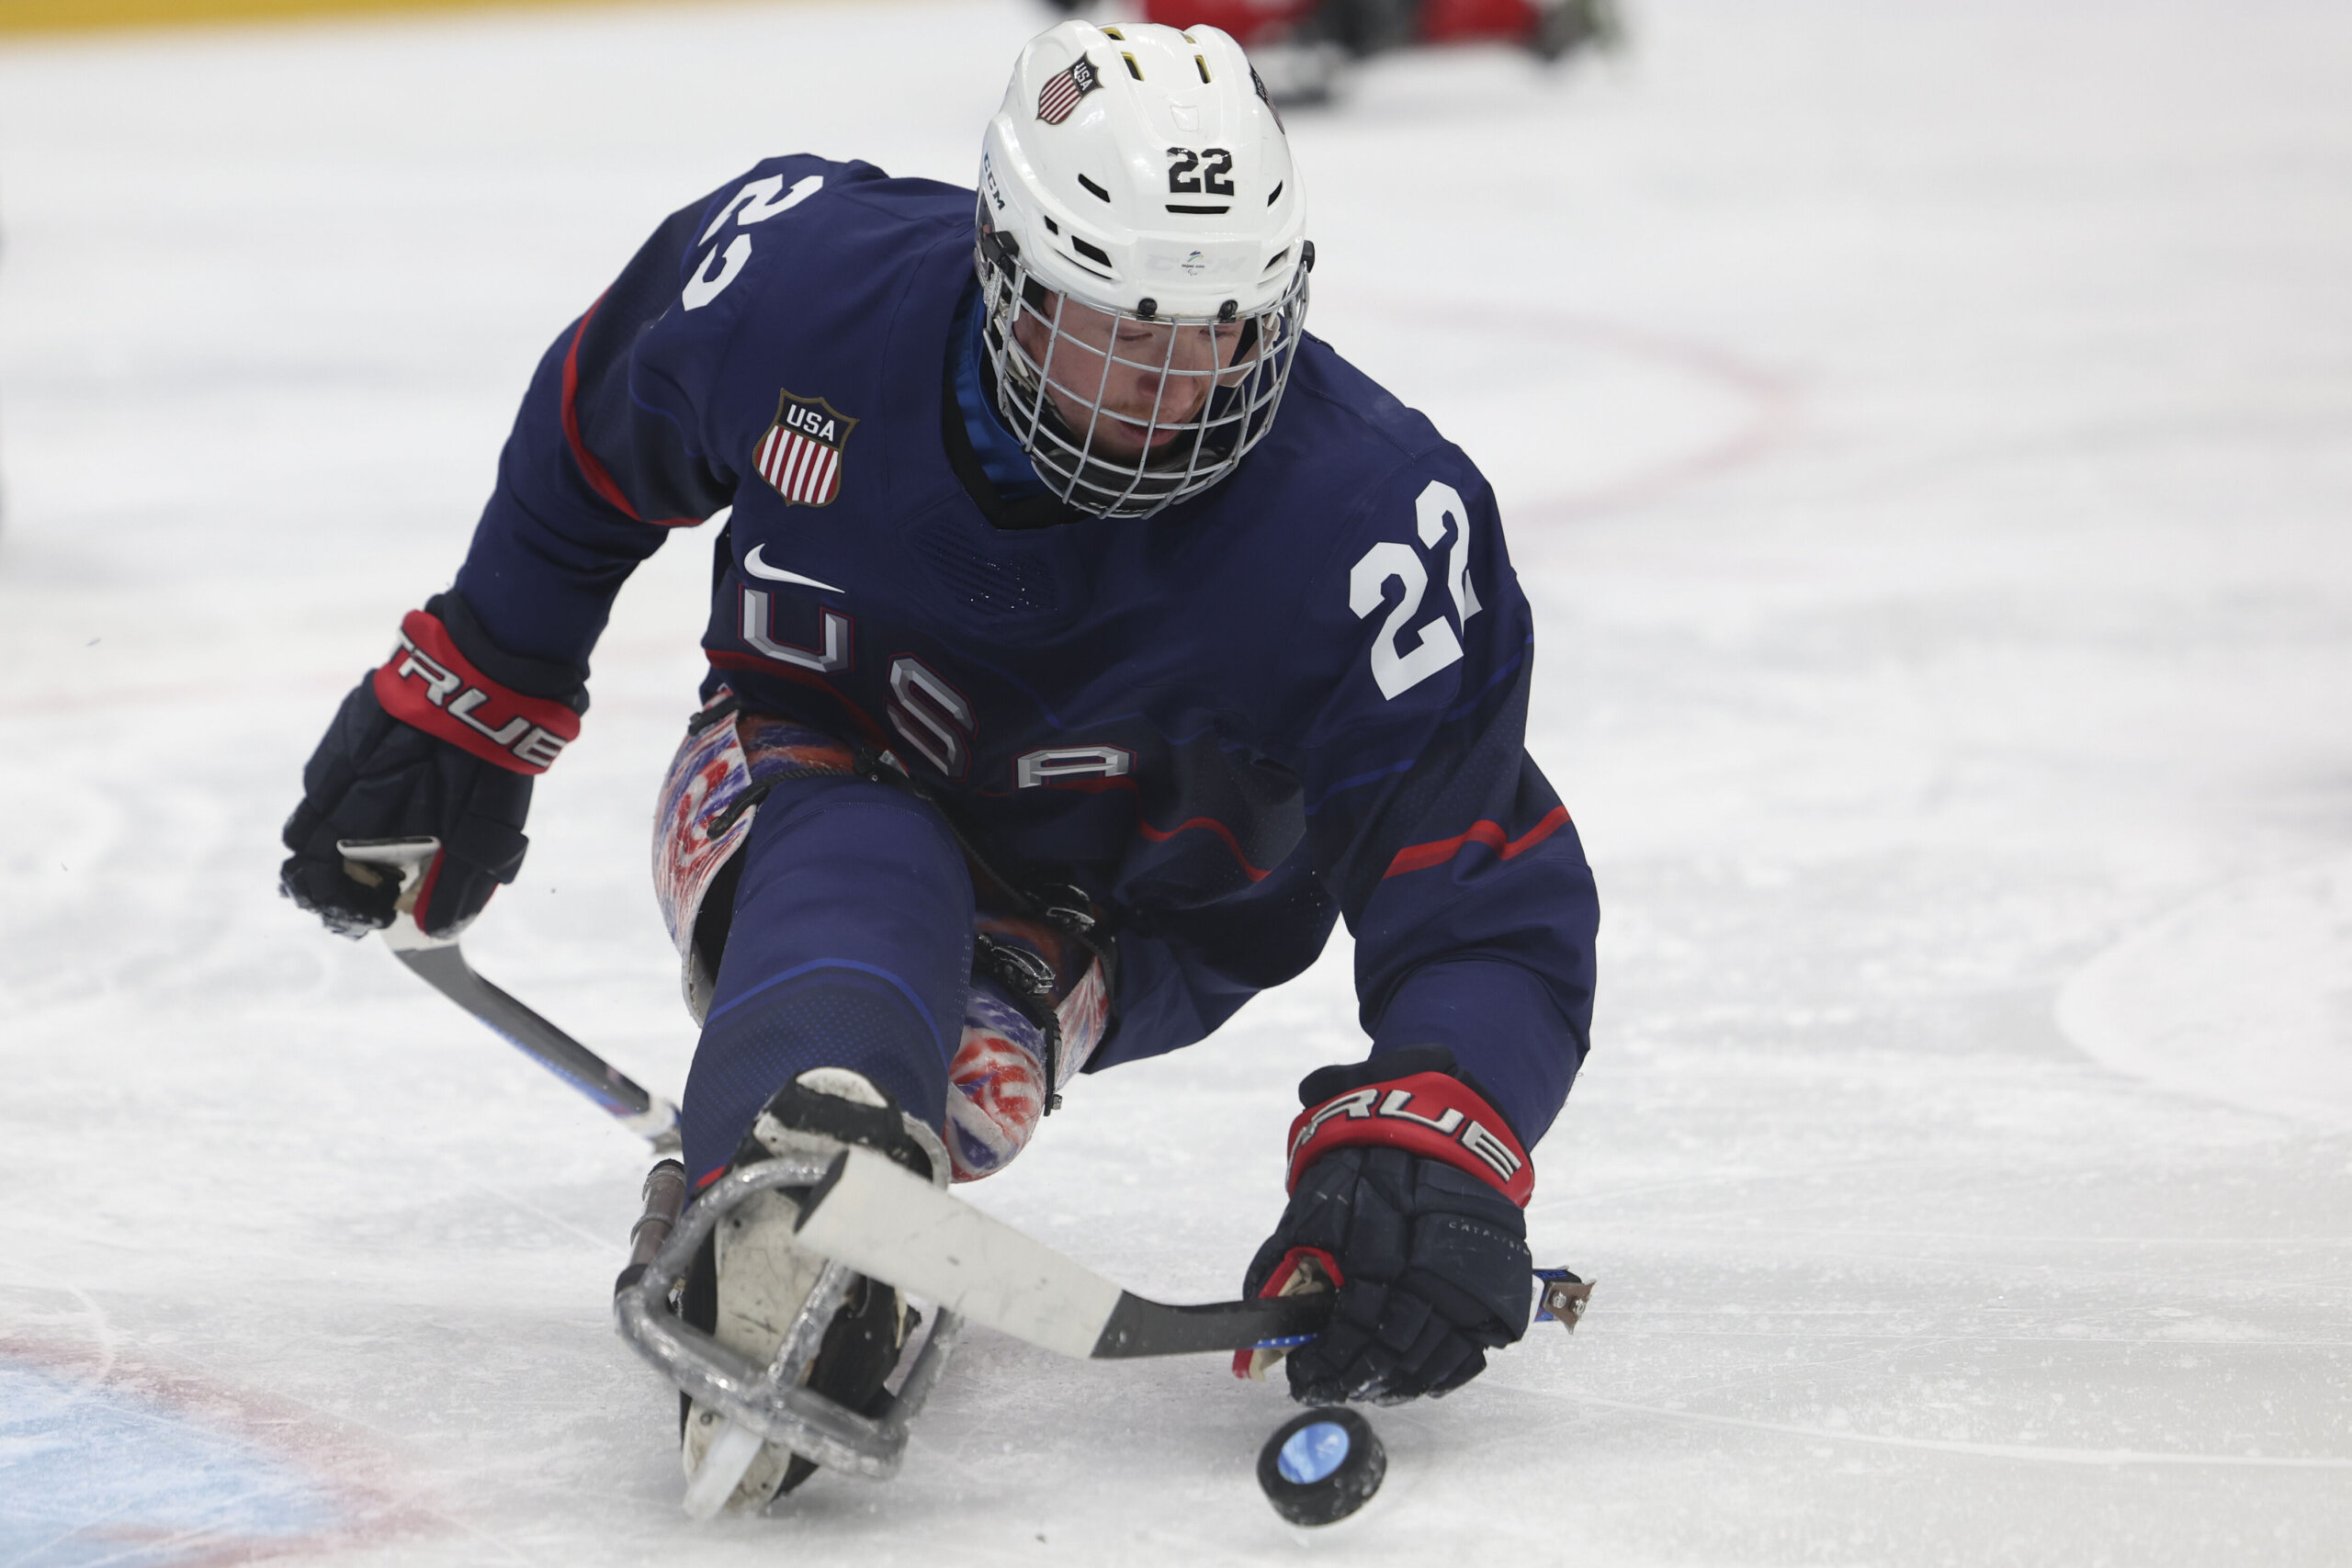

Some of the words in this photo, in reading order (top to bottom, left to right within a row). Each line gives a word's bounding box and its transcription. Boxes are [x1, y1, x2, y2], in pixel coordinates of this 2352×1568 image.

[1074, 62, 1092, 91] USA
[984, 151, 1005, 210] CCM
[1167, 147, 1235, 196] 22
[786, 404, 835, 442] USA
[1349, 479, 1483, 701] 22
